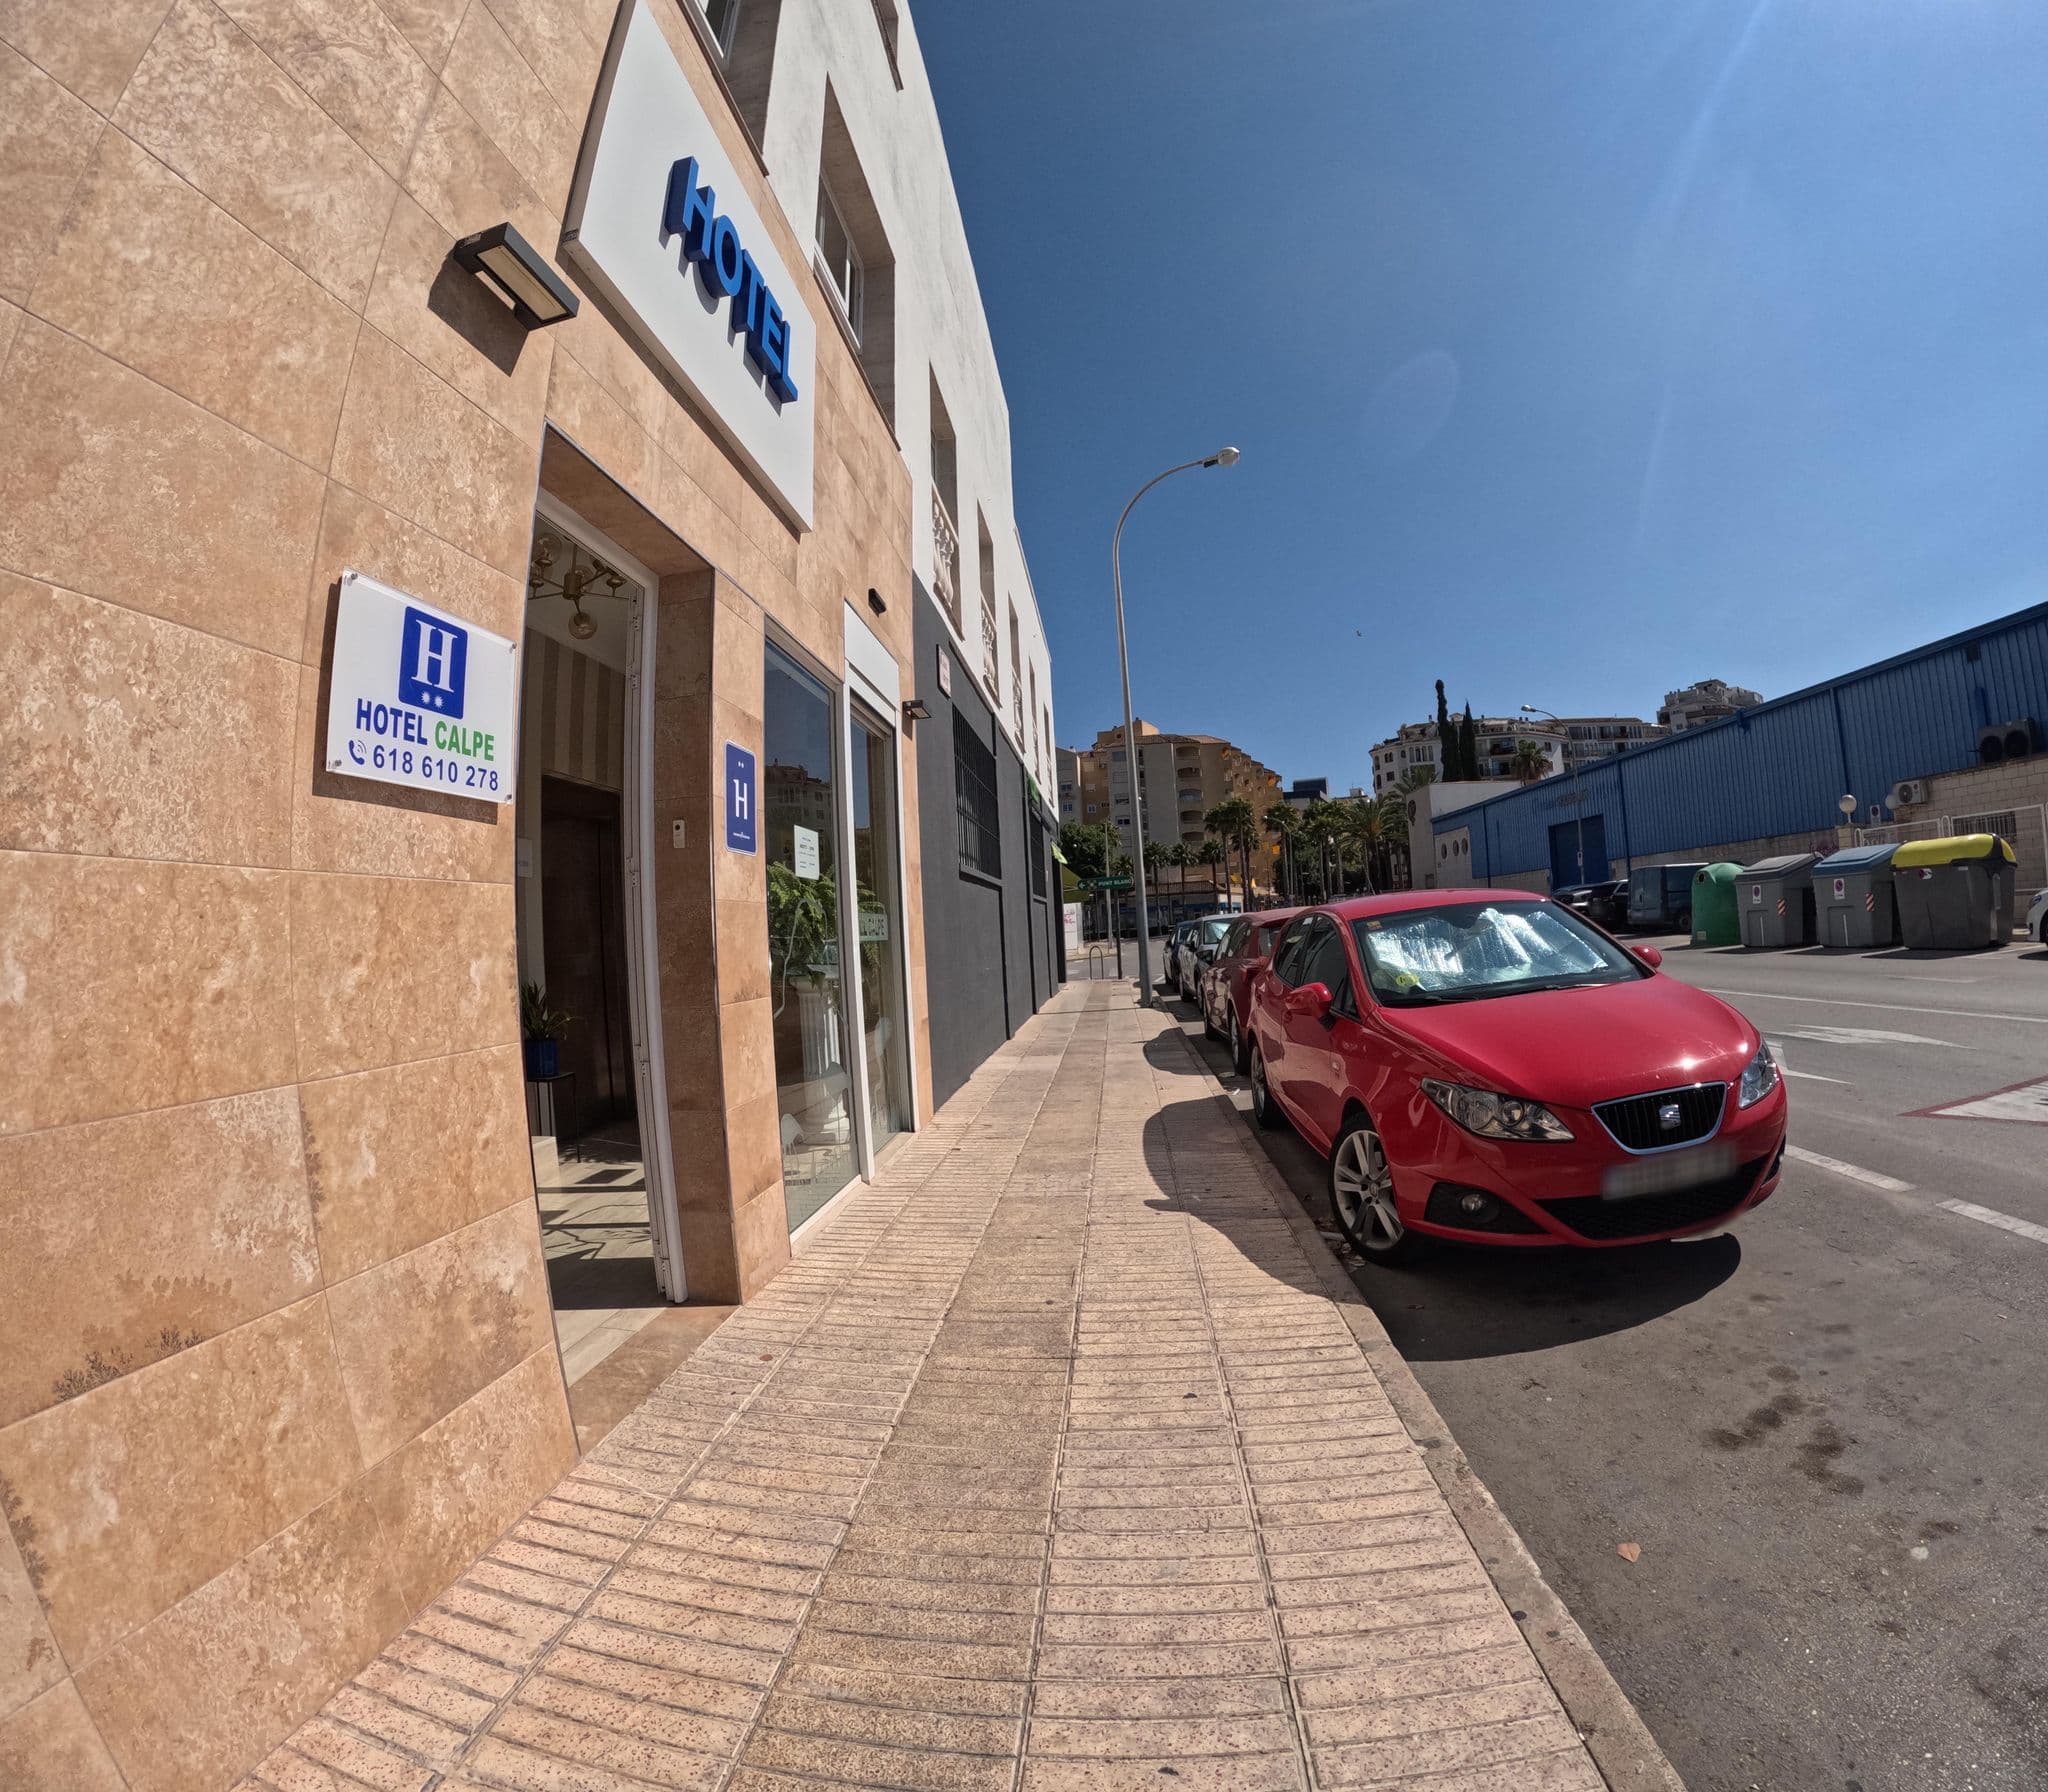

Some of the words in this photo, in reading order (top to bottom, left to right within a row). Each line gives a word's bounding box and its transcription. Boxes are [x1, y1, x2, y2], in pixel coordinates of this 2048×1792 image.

[665, 155, 798, 404] HOTEL
[410, 618, 458, 694] H
[355, 698, 428, 746] HOTEL
[434, 720, 495, 762] CALPE
[373, 744, 413, 775] 618
[421, 755, 458, 784] 610
[465, 765, 499, 791] 278
[733, 778, 748, 820] H
